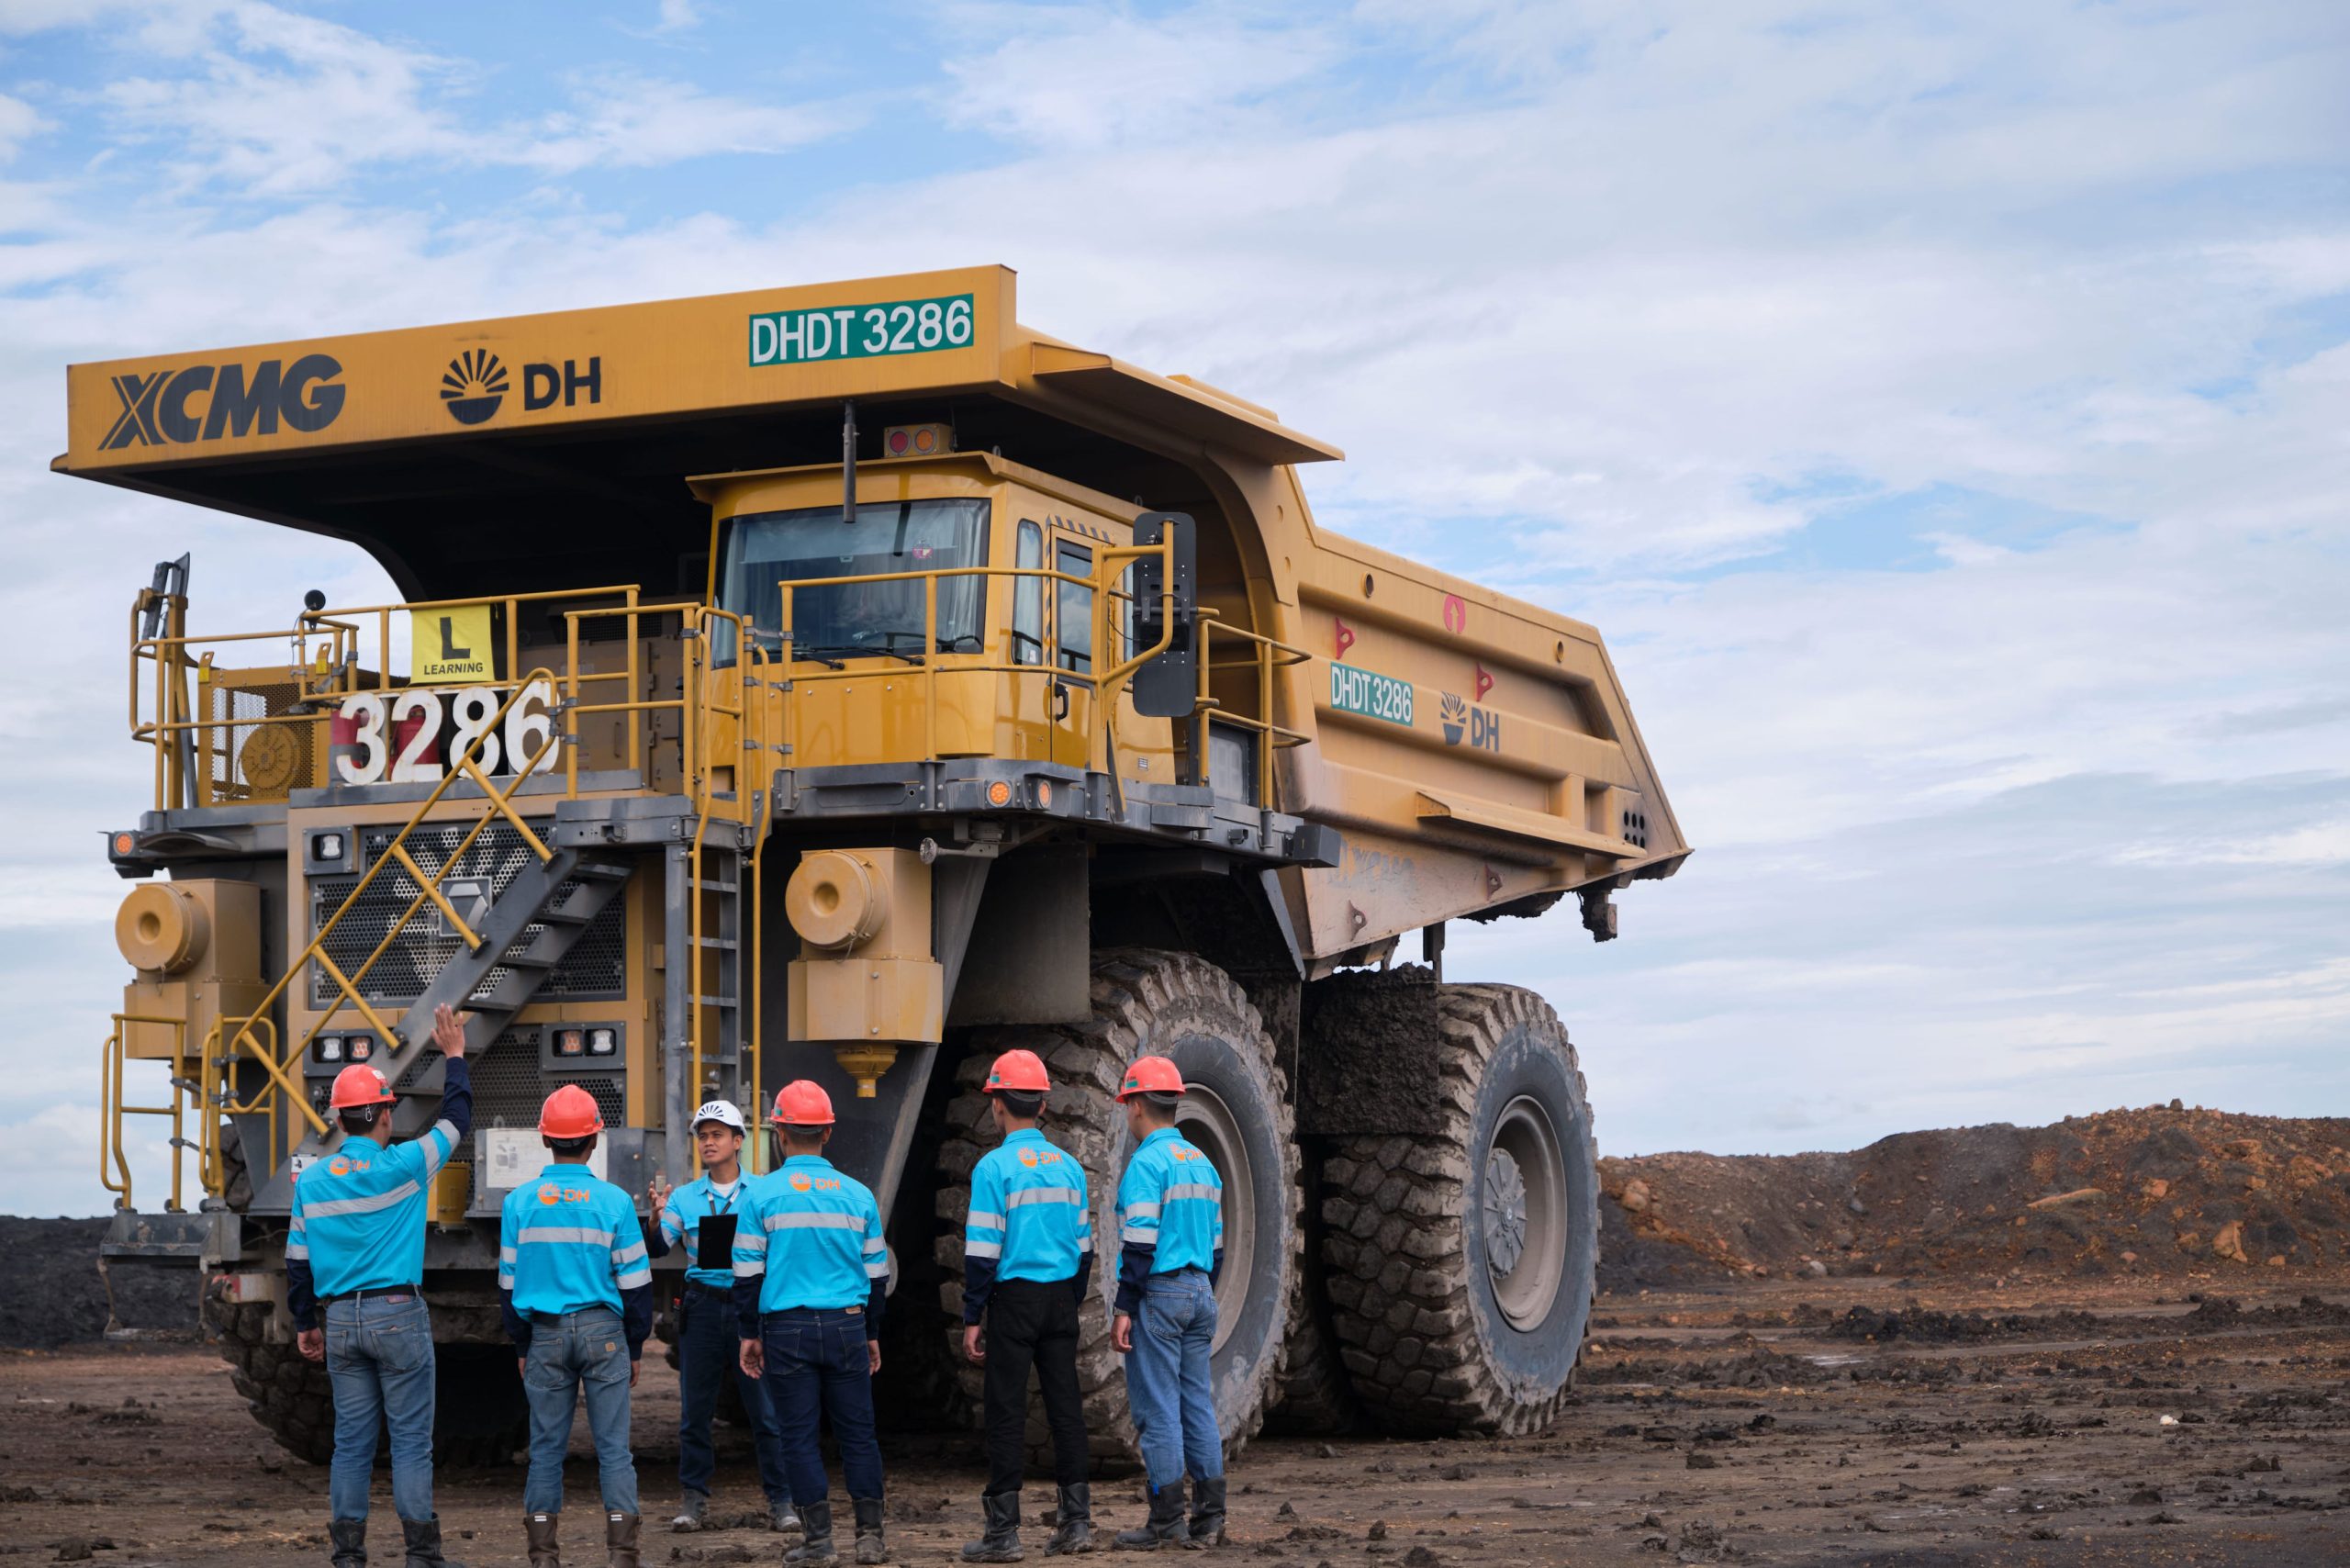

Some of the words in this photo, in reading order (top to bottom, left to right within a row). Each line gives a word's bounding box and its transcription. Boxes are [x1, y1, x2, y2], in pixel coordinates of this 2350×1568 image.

[751, 310, 856, 364] DHDT
[862, 299, 971, 353] 3286
[97, 353, 346, 451] XCMG
[523, 356, 601, 410] DH
[440, 616, 470, 660] L
[423, 662, 484, 676] LEARNING
[1331, 665, 1371, 712] DHDT
[1373, 677, 1412, 723] 3286
[336, 681, 561, 786] 3286
[1472, 707, 1499, 753] DH
[1040, 1151, 1063, 1165] DH
[564, 1189, 590, 1203] DH
[815, 1178, 841, 1191] DH
